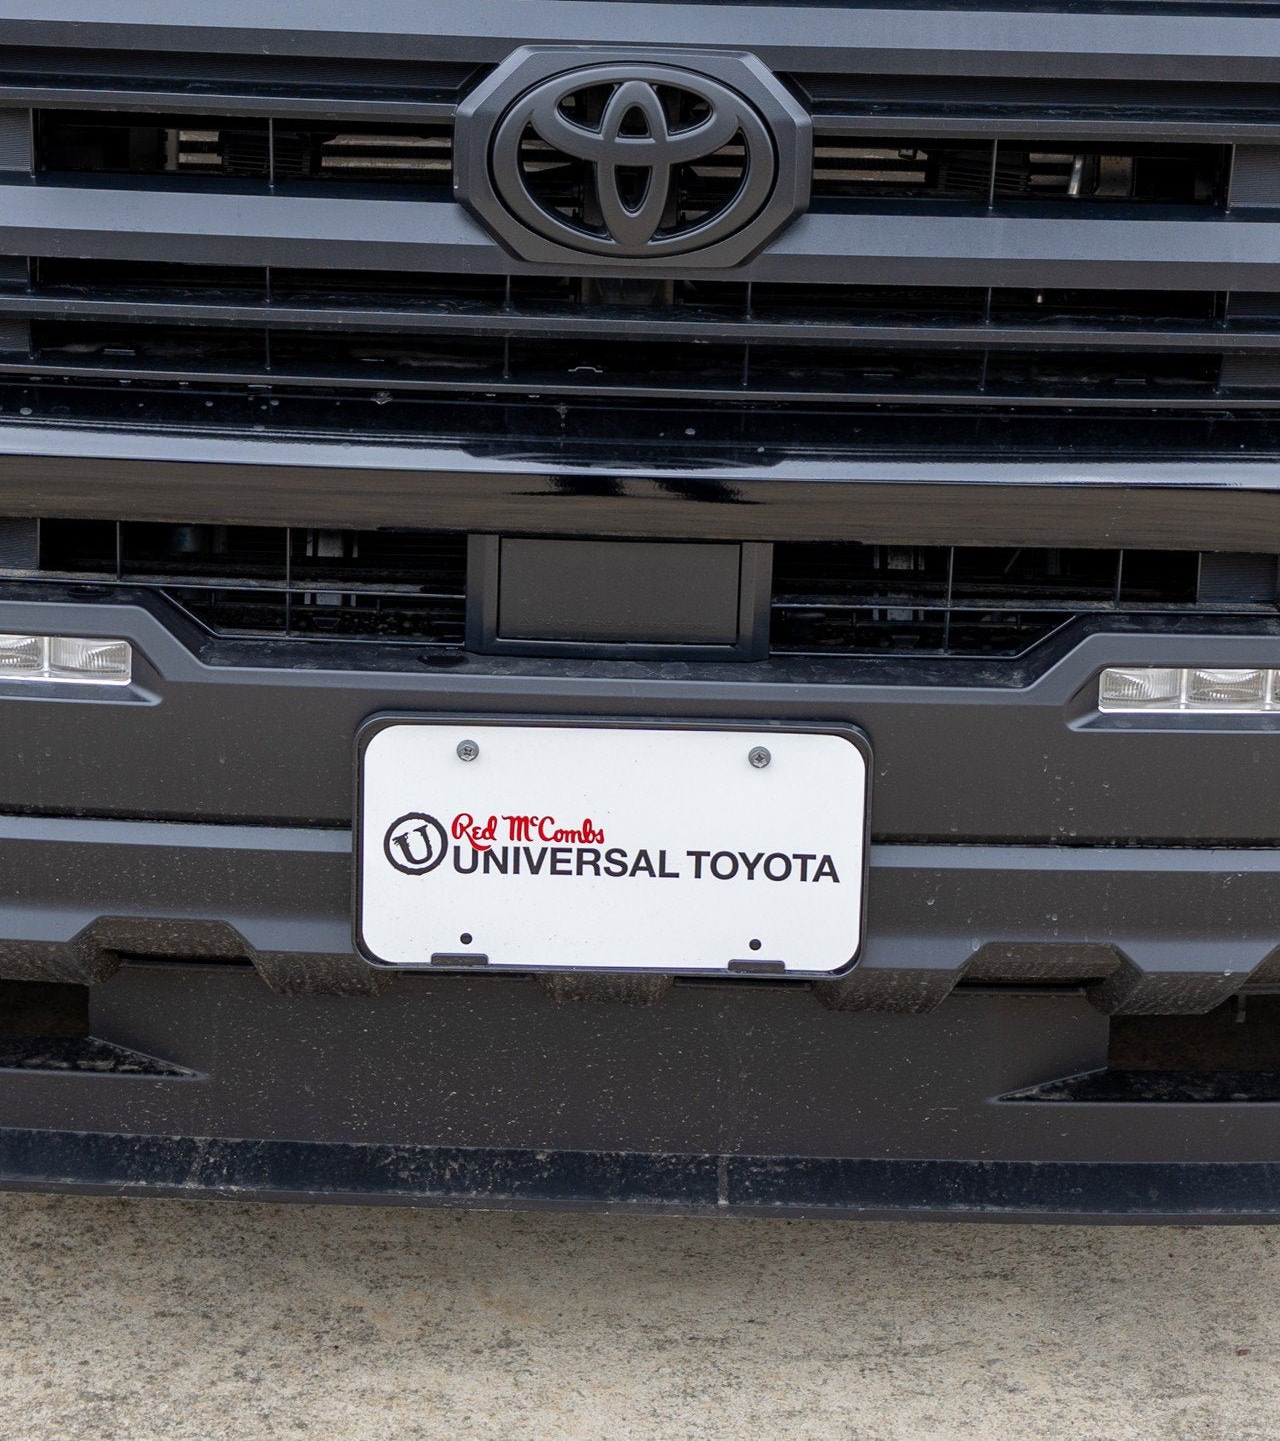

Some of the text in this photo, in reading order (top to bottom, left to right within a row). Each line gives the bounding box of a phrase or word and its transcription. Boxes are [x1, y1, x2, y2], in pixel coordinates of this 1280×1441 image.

[451, 813, 605, 851] Red McCombs
[453, 845, 840, 883] UNIVERSAL TOYOTA
